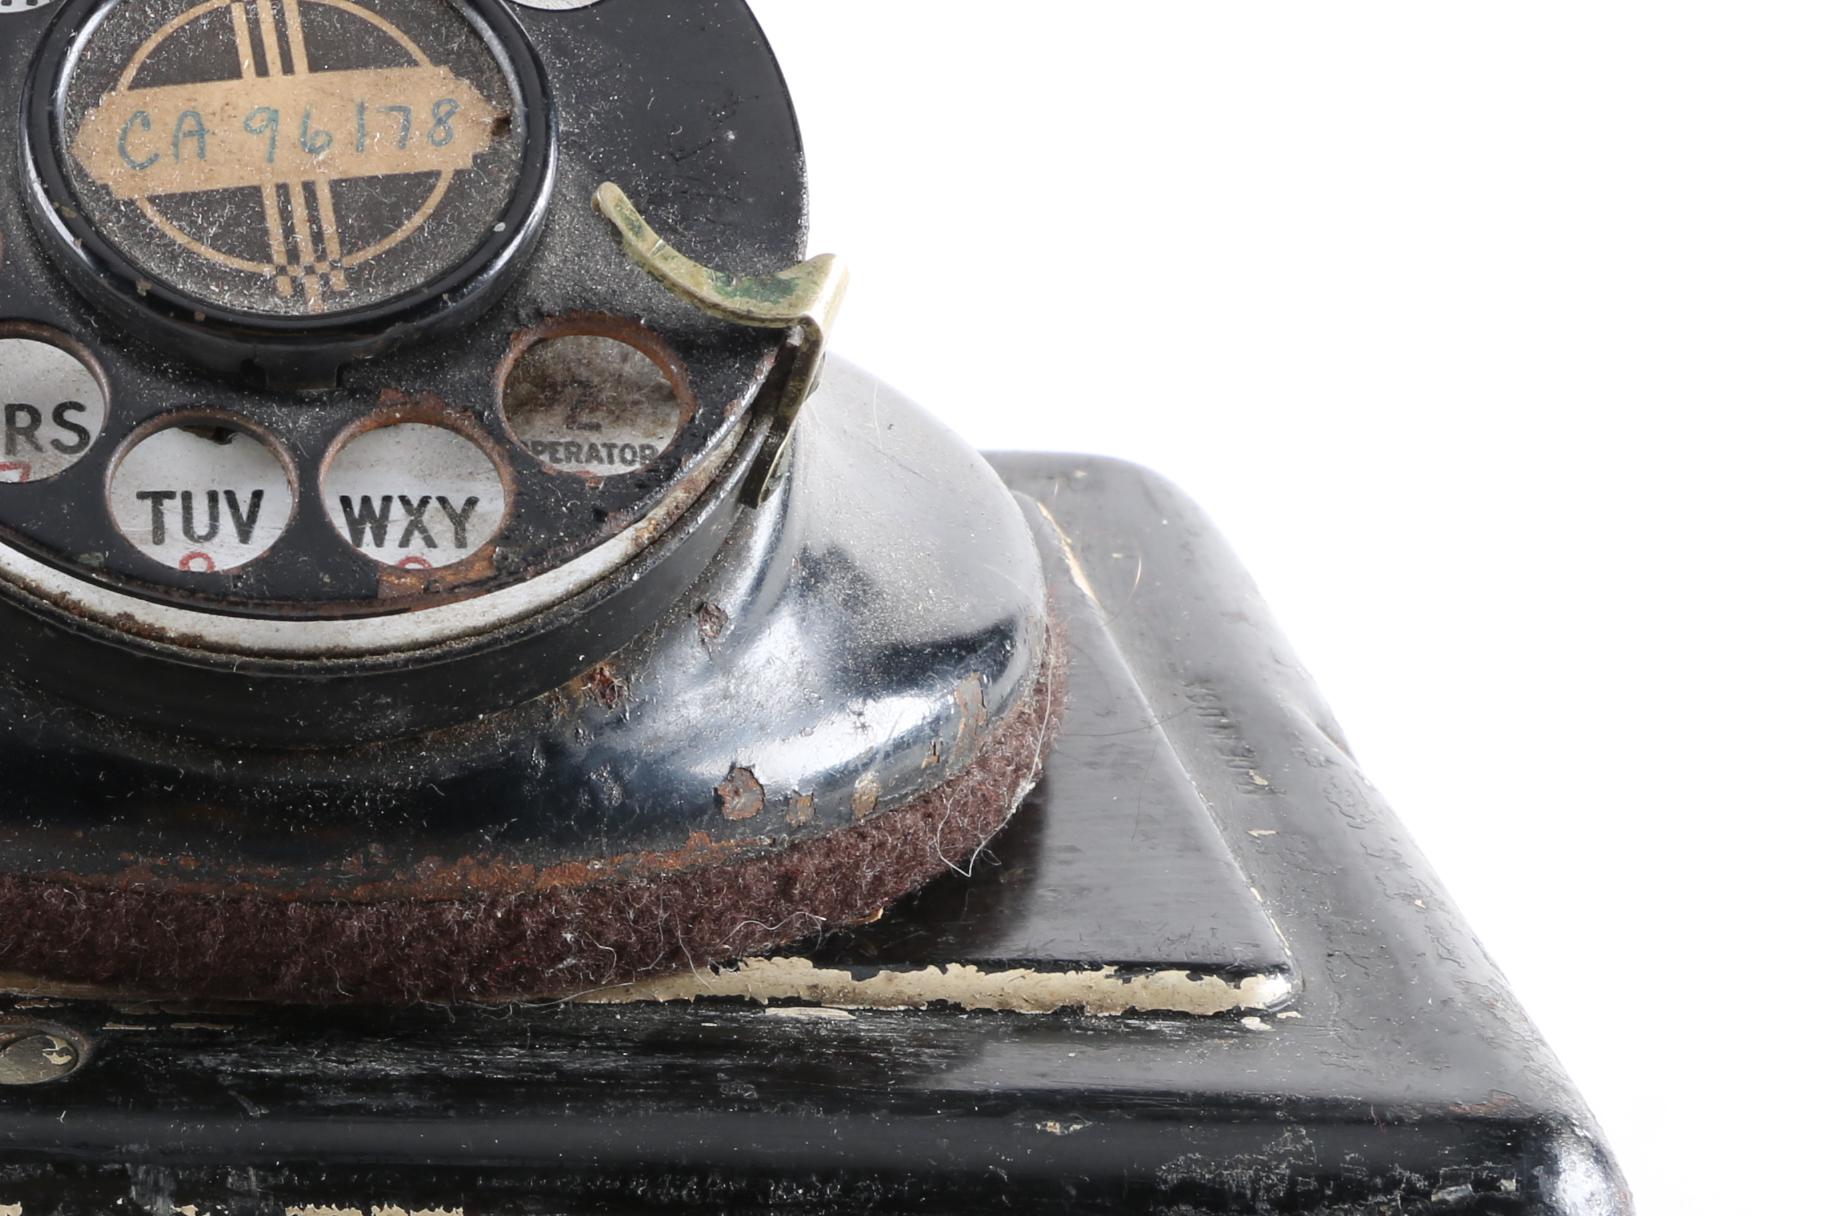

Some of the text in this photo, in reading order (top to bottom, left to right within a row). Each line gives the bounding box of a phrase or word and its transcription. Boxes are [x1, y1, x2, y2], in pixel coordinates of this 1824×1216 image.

[116, 97, 466, 170] CA 96178
[520, 439, 659, 466] PERATOR
[135, 489, 265, 546] TUV
[338, 494, 480, 549] WXY
